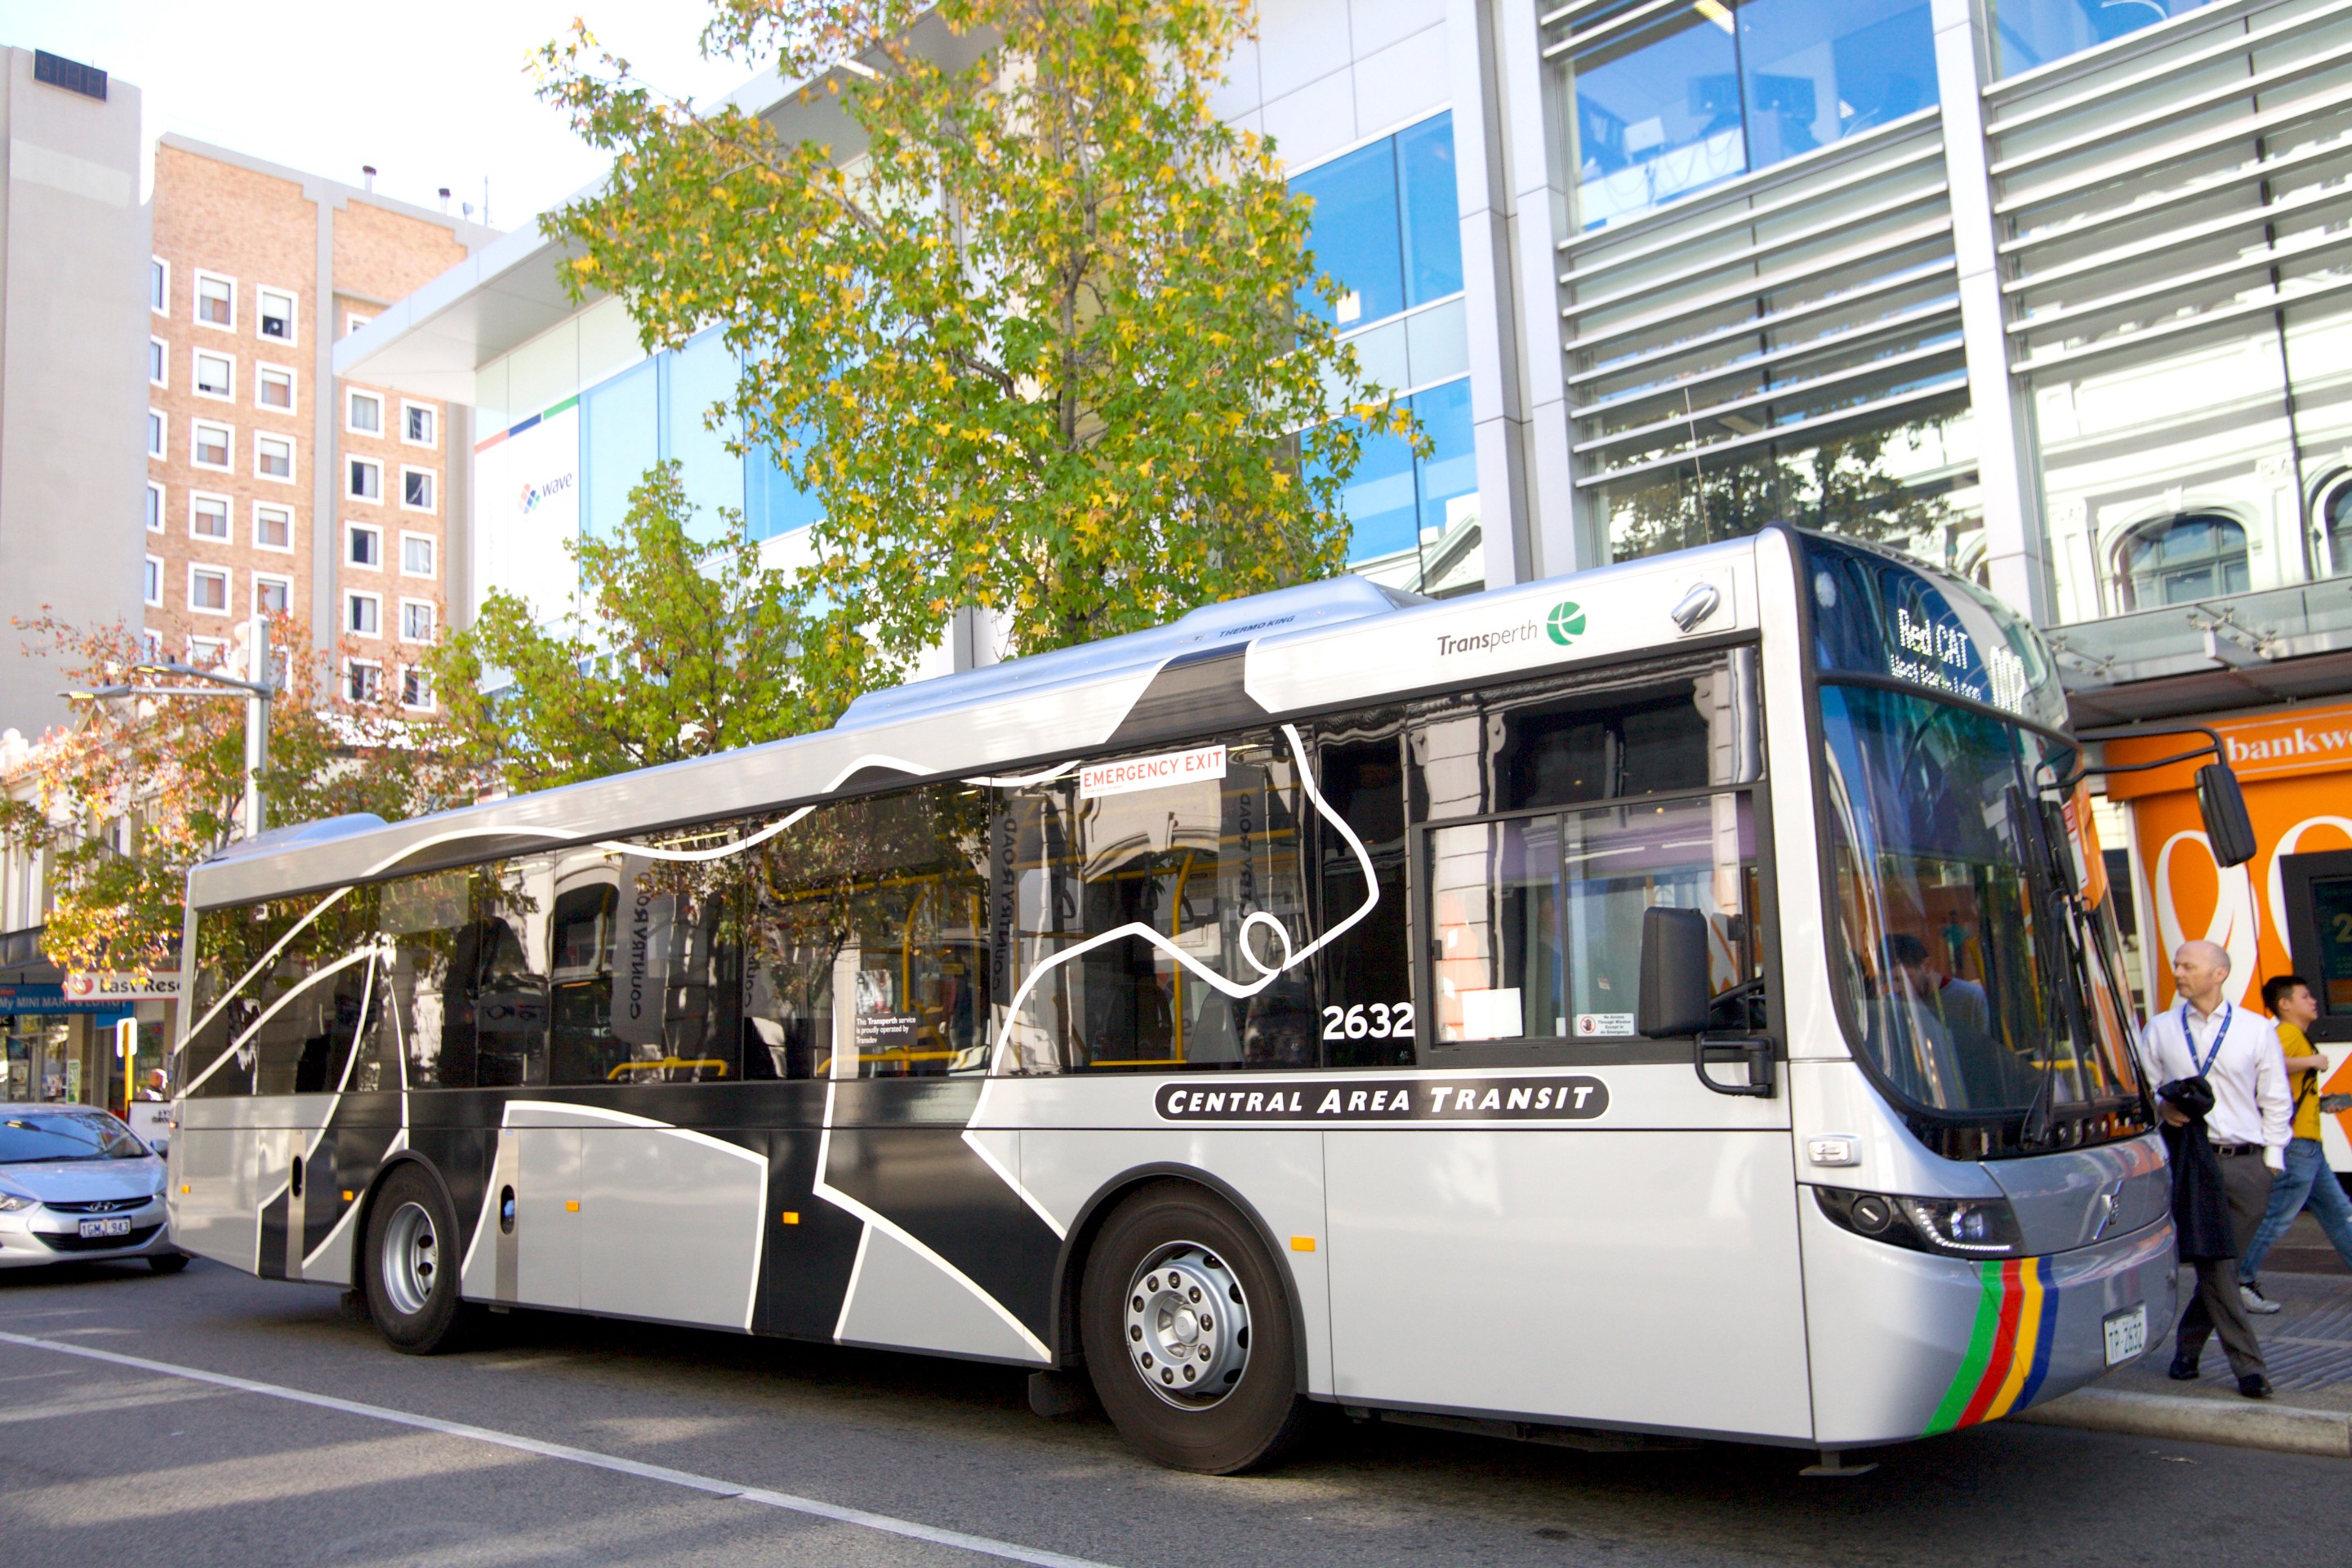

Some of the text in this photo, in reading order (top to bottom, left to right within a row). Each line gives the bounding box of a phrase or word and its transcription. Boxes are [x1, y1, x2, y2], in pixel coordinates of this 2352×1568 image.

[542, 473, 572, 497] wave
[1218, 615, 1296, 638] THERMO KING
[1437, 619, 1538, 656] Transperth
[1897, 608, 1968, 670] Red CAT
[2225, 728, 2352, 763] bankw
[1084, 751, 1223, 788] EMERGENCY EXIT
[861, 1026, 880, 1036] proudly
[880, 1025, 902, 1035] operated
[902, 1024, 909, 1034] by
[867, 1016, 898, 1027] Transperth
[1322, 1001, 1415, 1040] 2632
[856, 1036, 878, 1045] Transdev
[1166, 1085, 1594, 1114] CENTRAL AREA TRANSIT
